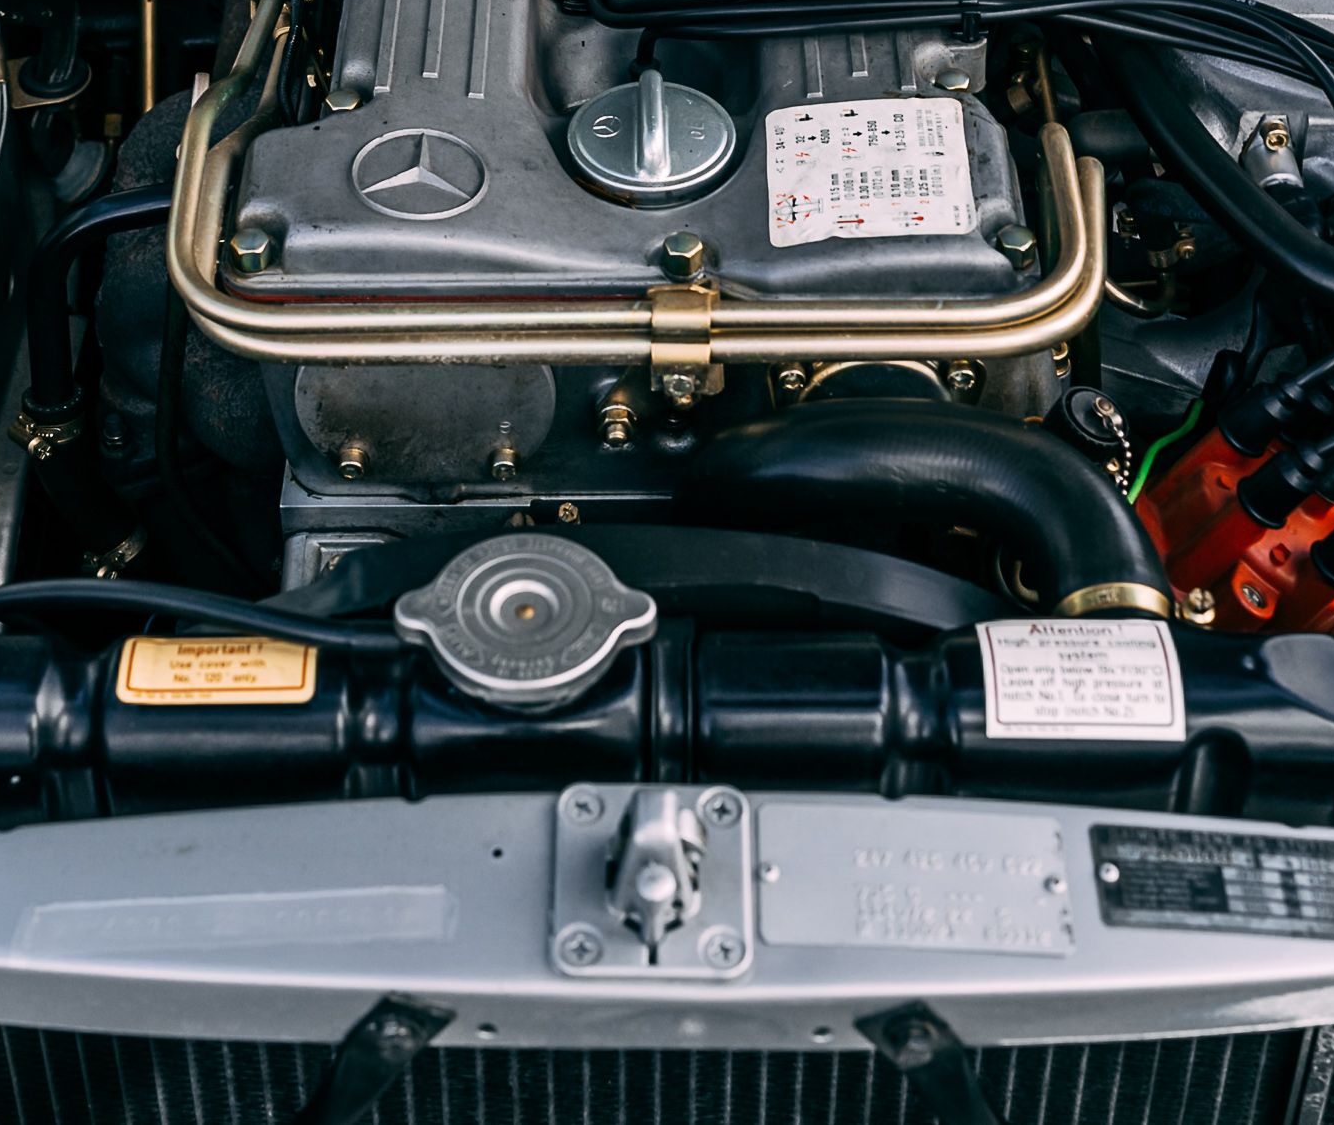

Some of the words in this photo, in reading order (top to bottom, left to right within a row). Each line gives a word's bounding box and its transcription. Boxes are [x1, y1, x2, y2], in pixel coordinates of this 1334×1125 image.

[1029, 624, 1112, 636] Attention
[177, 644, 251, 656] Important
[1058, 651, 1108, 661] system
[169, 660, 192, 669] Use
